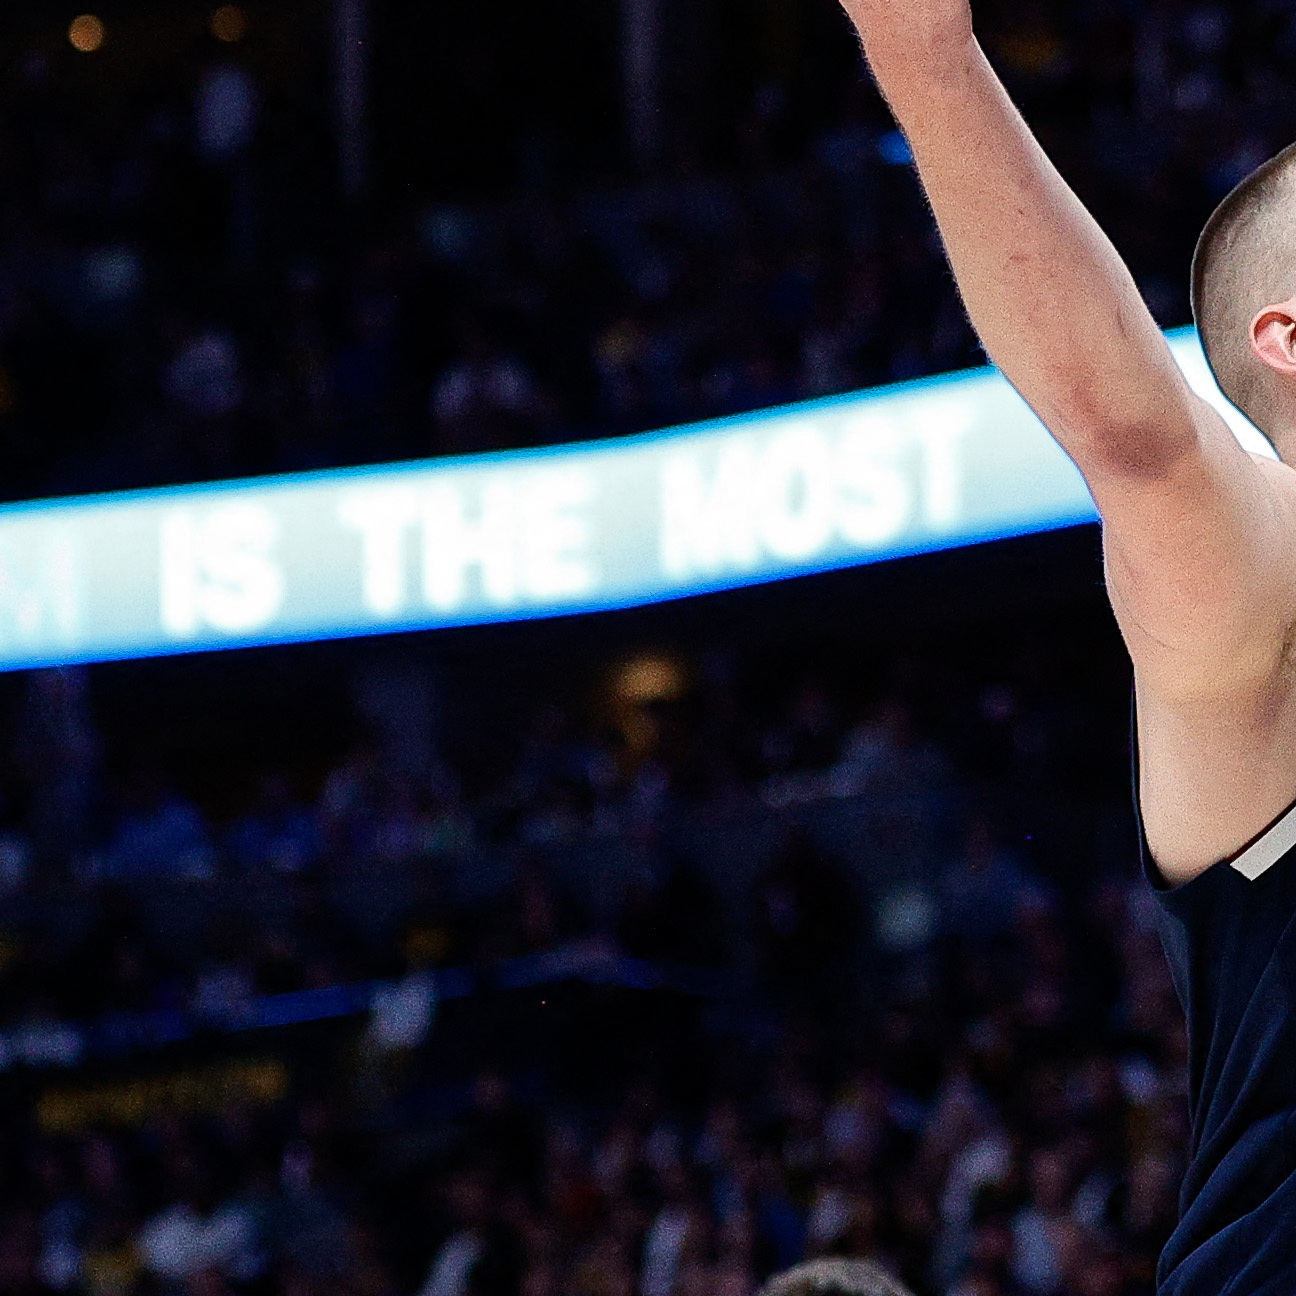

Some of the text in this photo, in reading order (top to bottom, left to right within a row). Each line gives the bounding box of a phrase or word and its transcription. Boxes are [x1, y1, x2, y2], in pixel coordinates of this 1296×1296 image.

[161, 501, 282, 633] IS
[337, 465, 597, 612] THE
[660, 396, 979, 573] MOST
